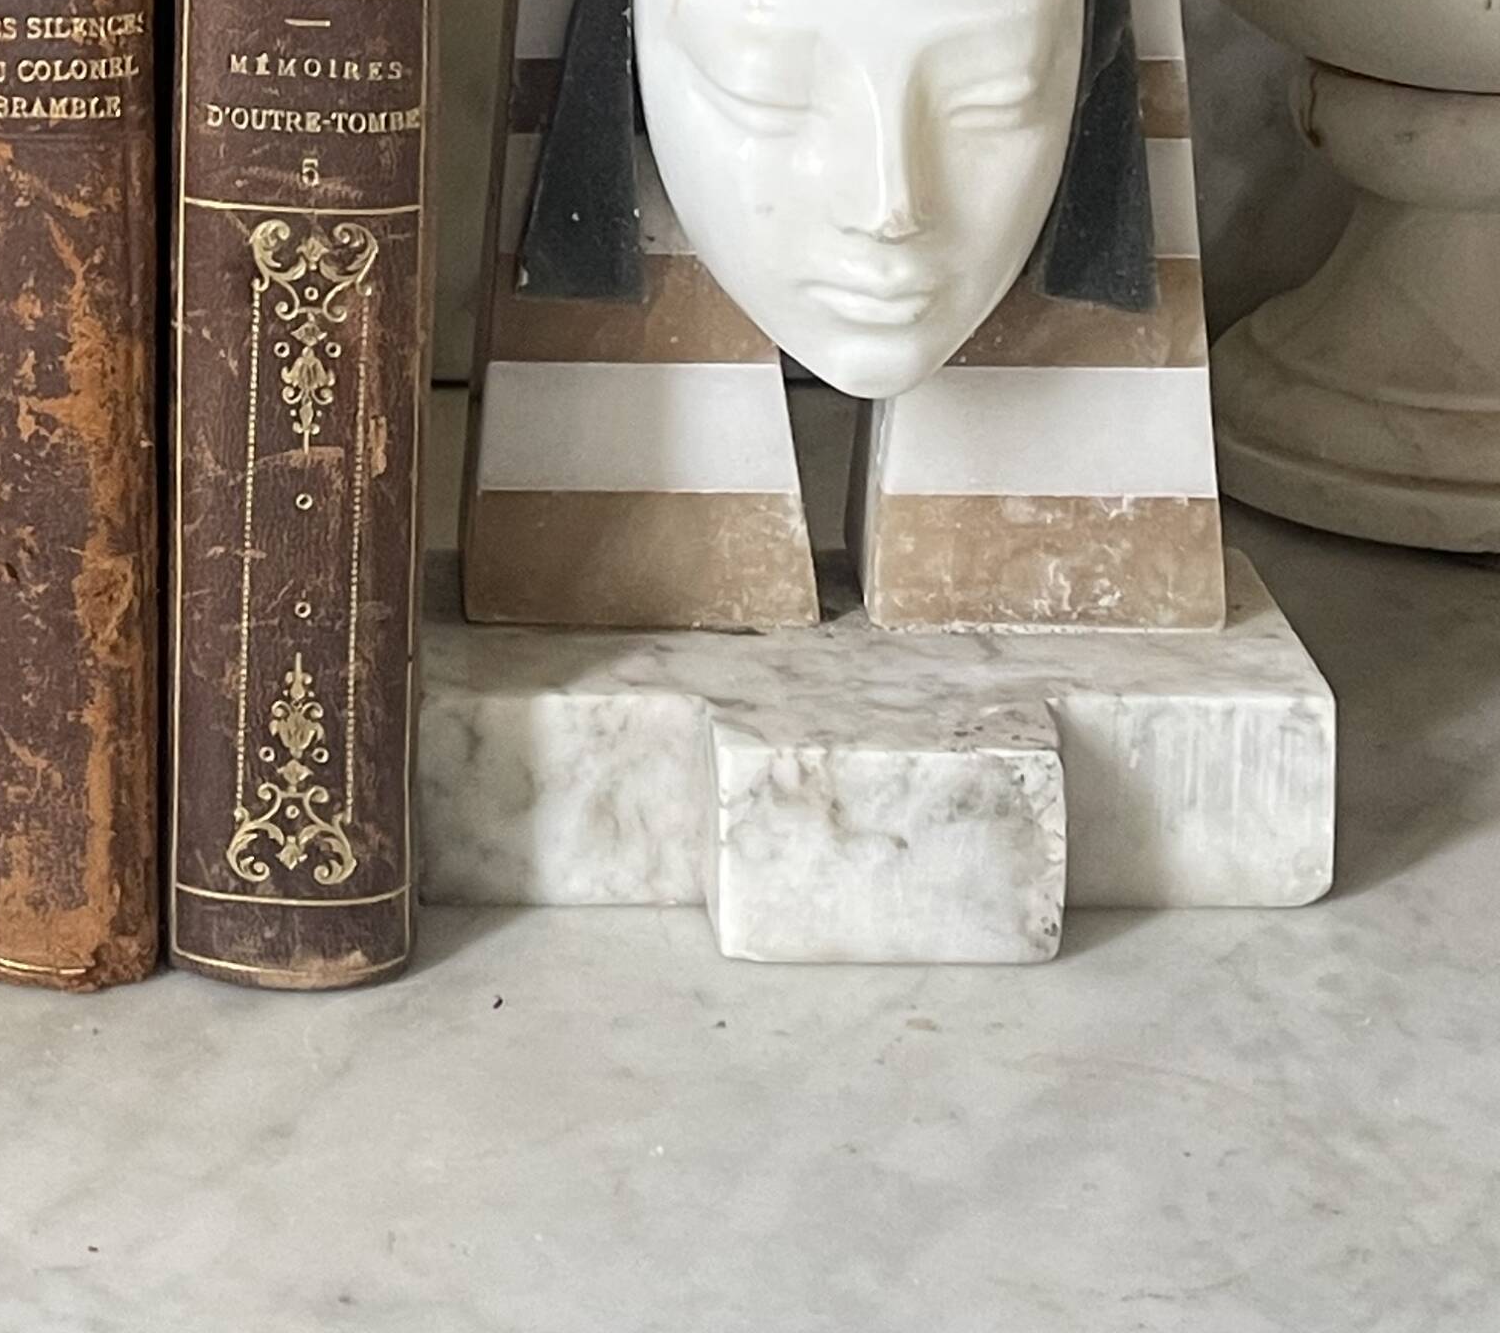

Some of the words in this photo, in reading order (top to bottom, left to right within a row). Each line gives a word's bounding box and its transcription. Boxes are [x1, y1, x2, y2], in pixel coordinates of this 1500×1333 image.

[17, 53, 139, 83] COLONEL
[205, 103, 422, 134] D'OUTRE-TOMBE
[300, 157, 321, 188] 5
